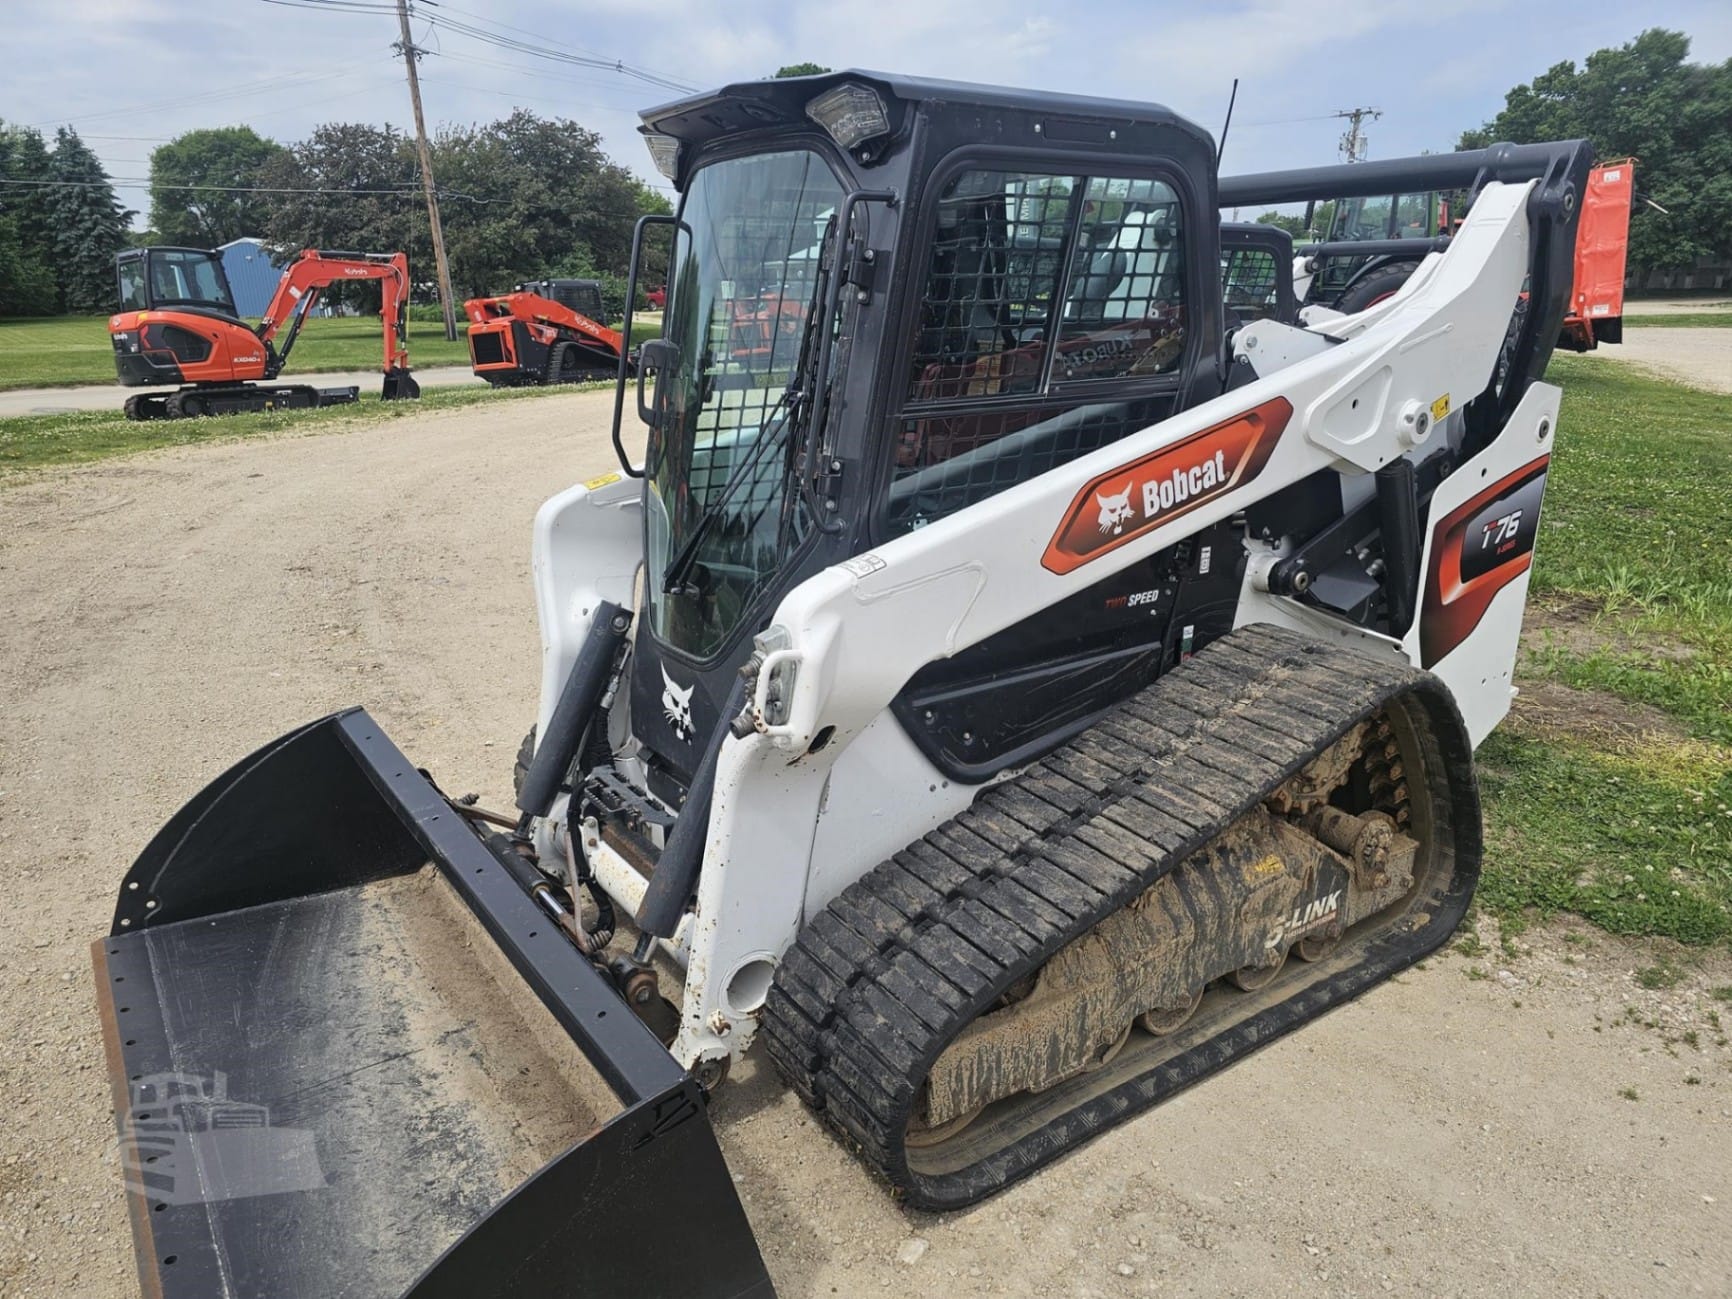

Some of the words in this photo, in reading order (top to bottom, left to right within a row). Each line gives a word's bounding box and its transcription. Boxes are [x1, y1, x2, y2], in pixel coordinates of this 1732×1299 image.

[1142, 449, 1225, 518] Bobcat
[1482, 510, 1522, 550] T76
[1127, 589, 1160, 608] SPEED
